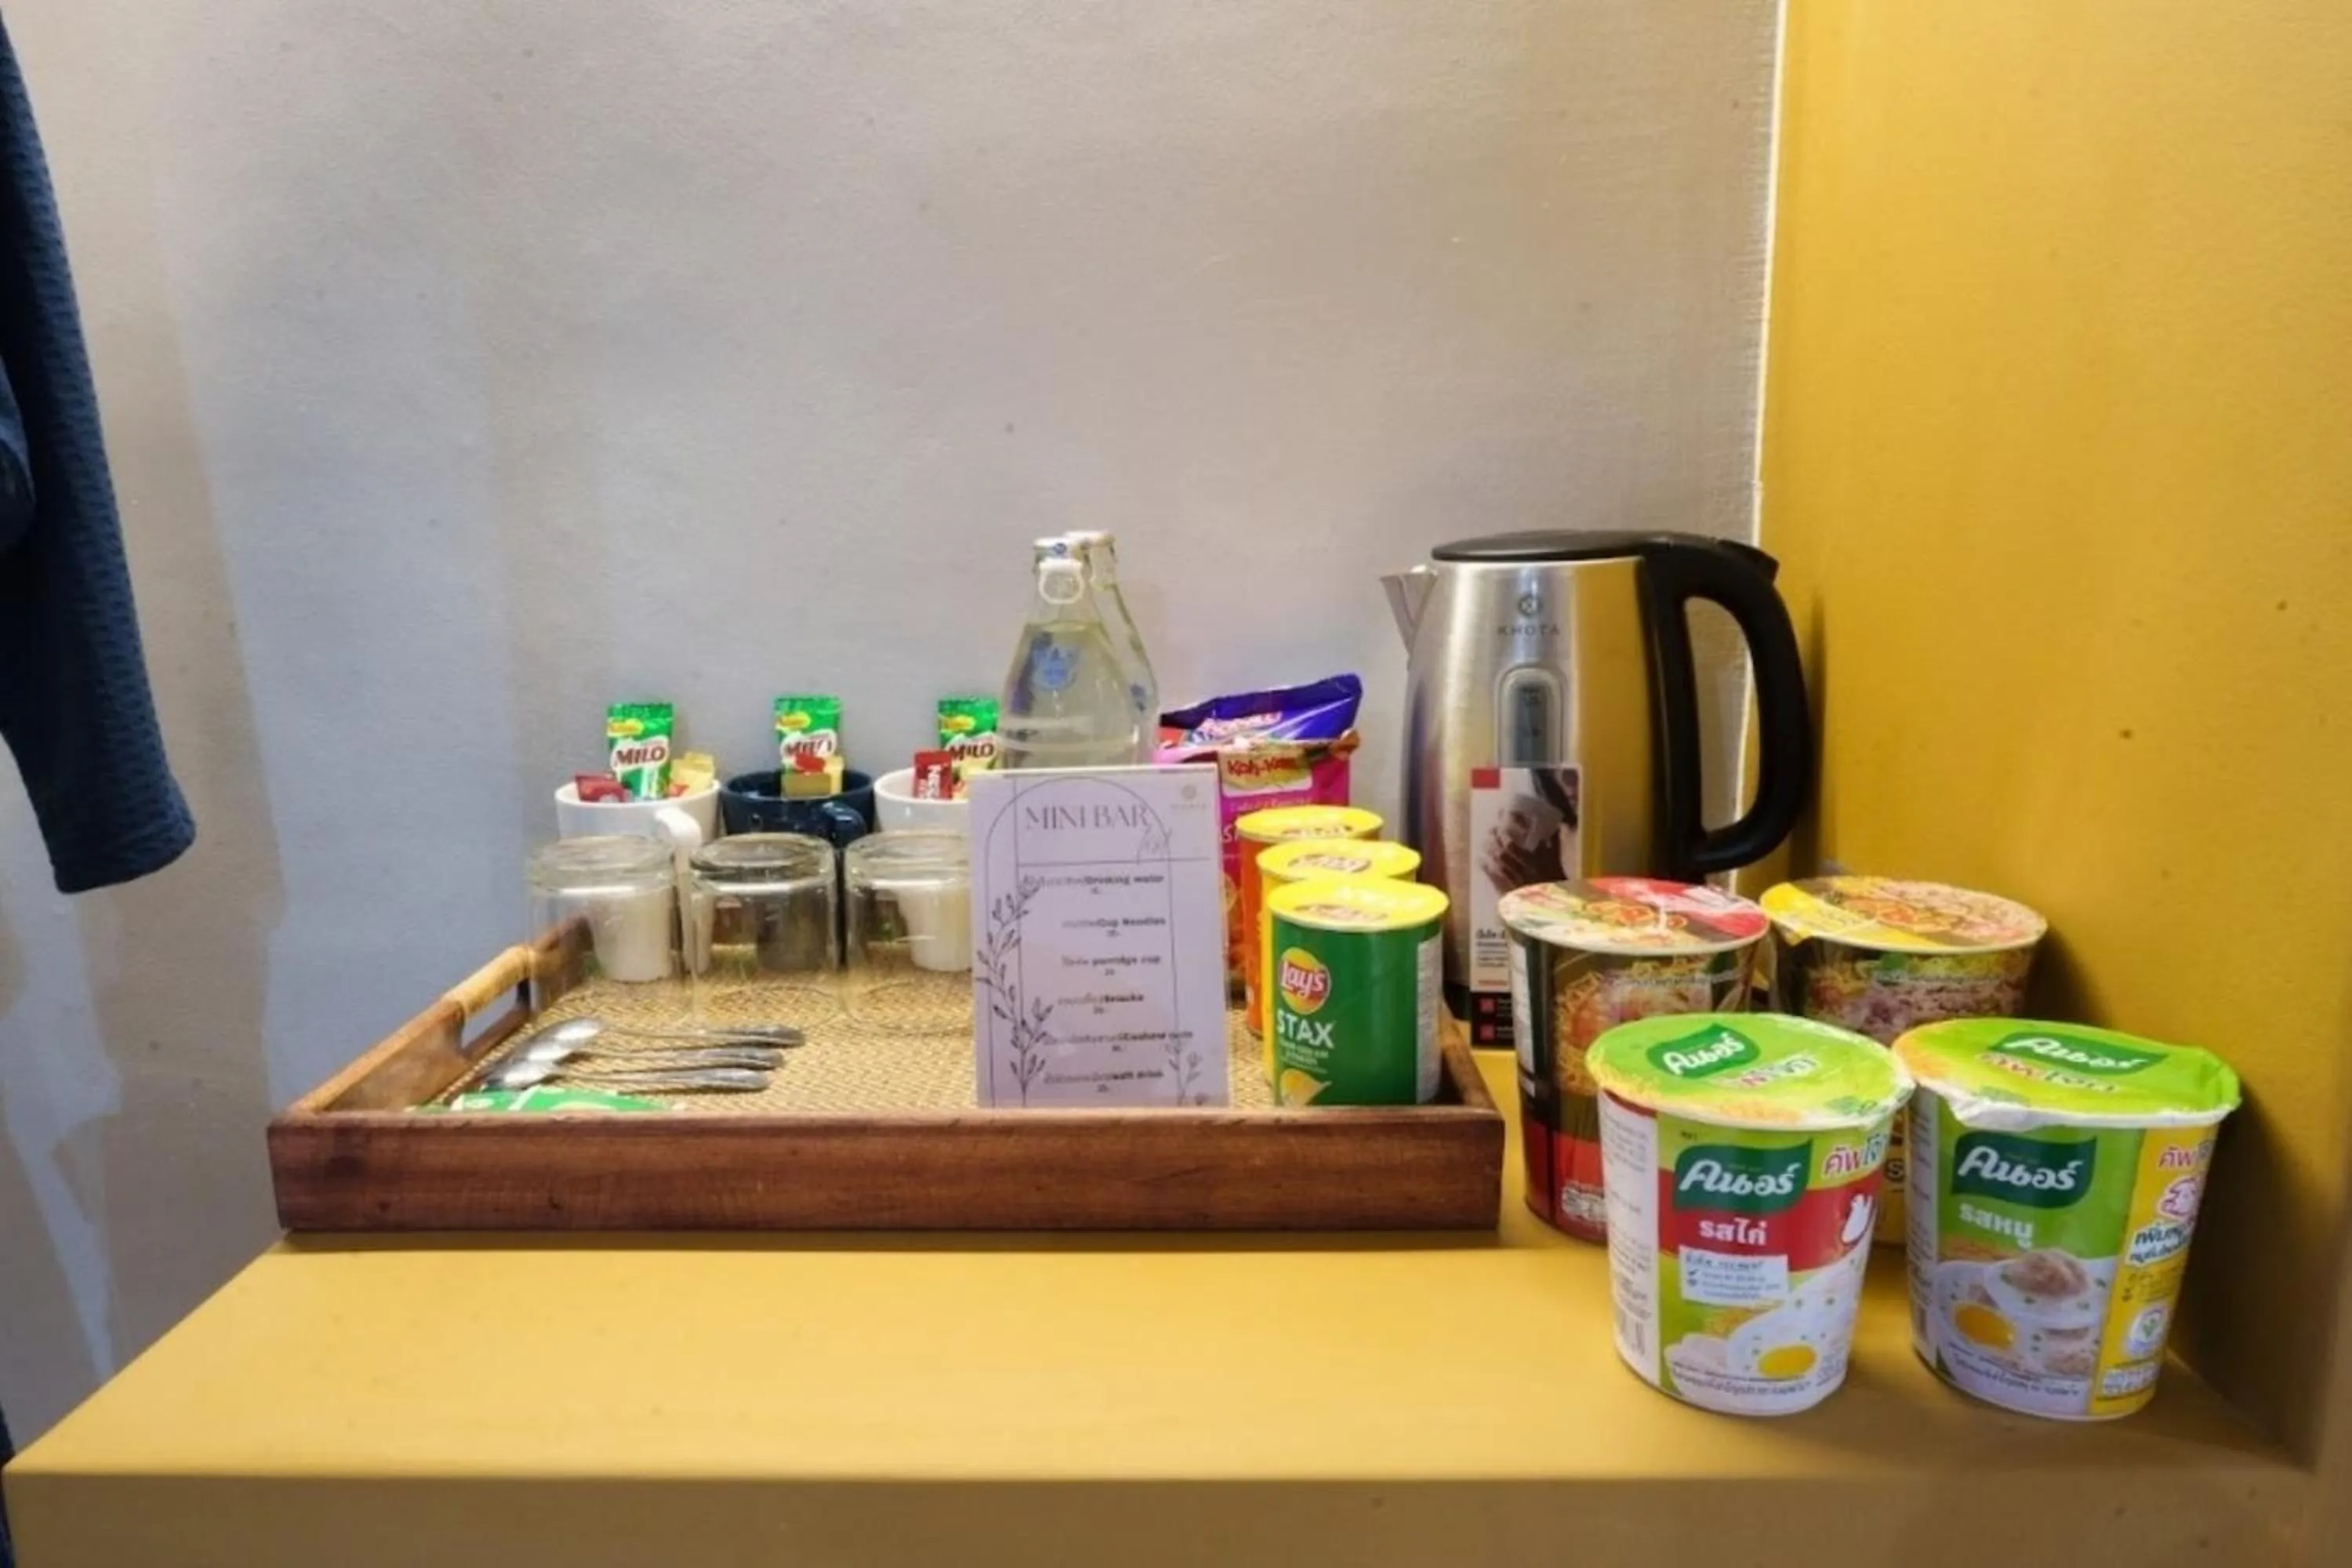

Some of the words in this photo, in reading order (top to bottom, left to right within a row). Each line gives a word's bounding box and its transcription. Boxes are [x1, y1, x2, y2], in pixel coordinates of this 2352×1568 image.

[615, 746, 666, 765] MILO
[949, 743, 995, 761] MILO
[1025, 805, 1086, 830] MINI
[1093, 804, 1149, 829] BAR
[1280, 960, 1325, 999] Lay's
[1277, 1008, 1336, 1049] STAX
[1698, 1217, 1768, 1246] รสไก่
[1960, 1203, 2034, 1250] รสหมู
